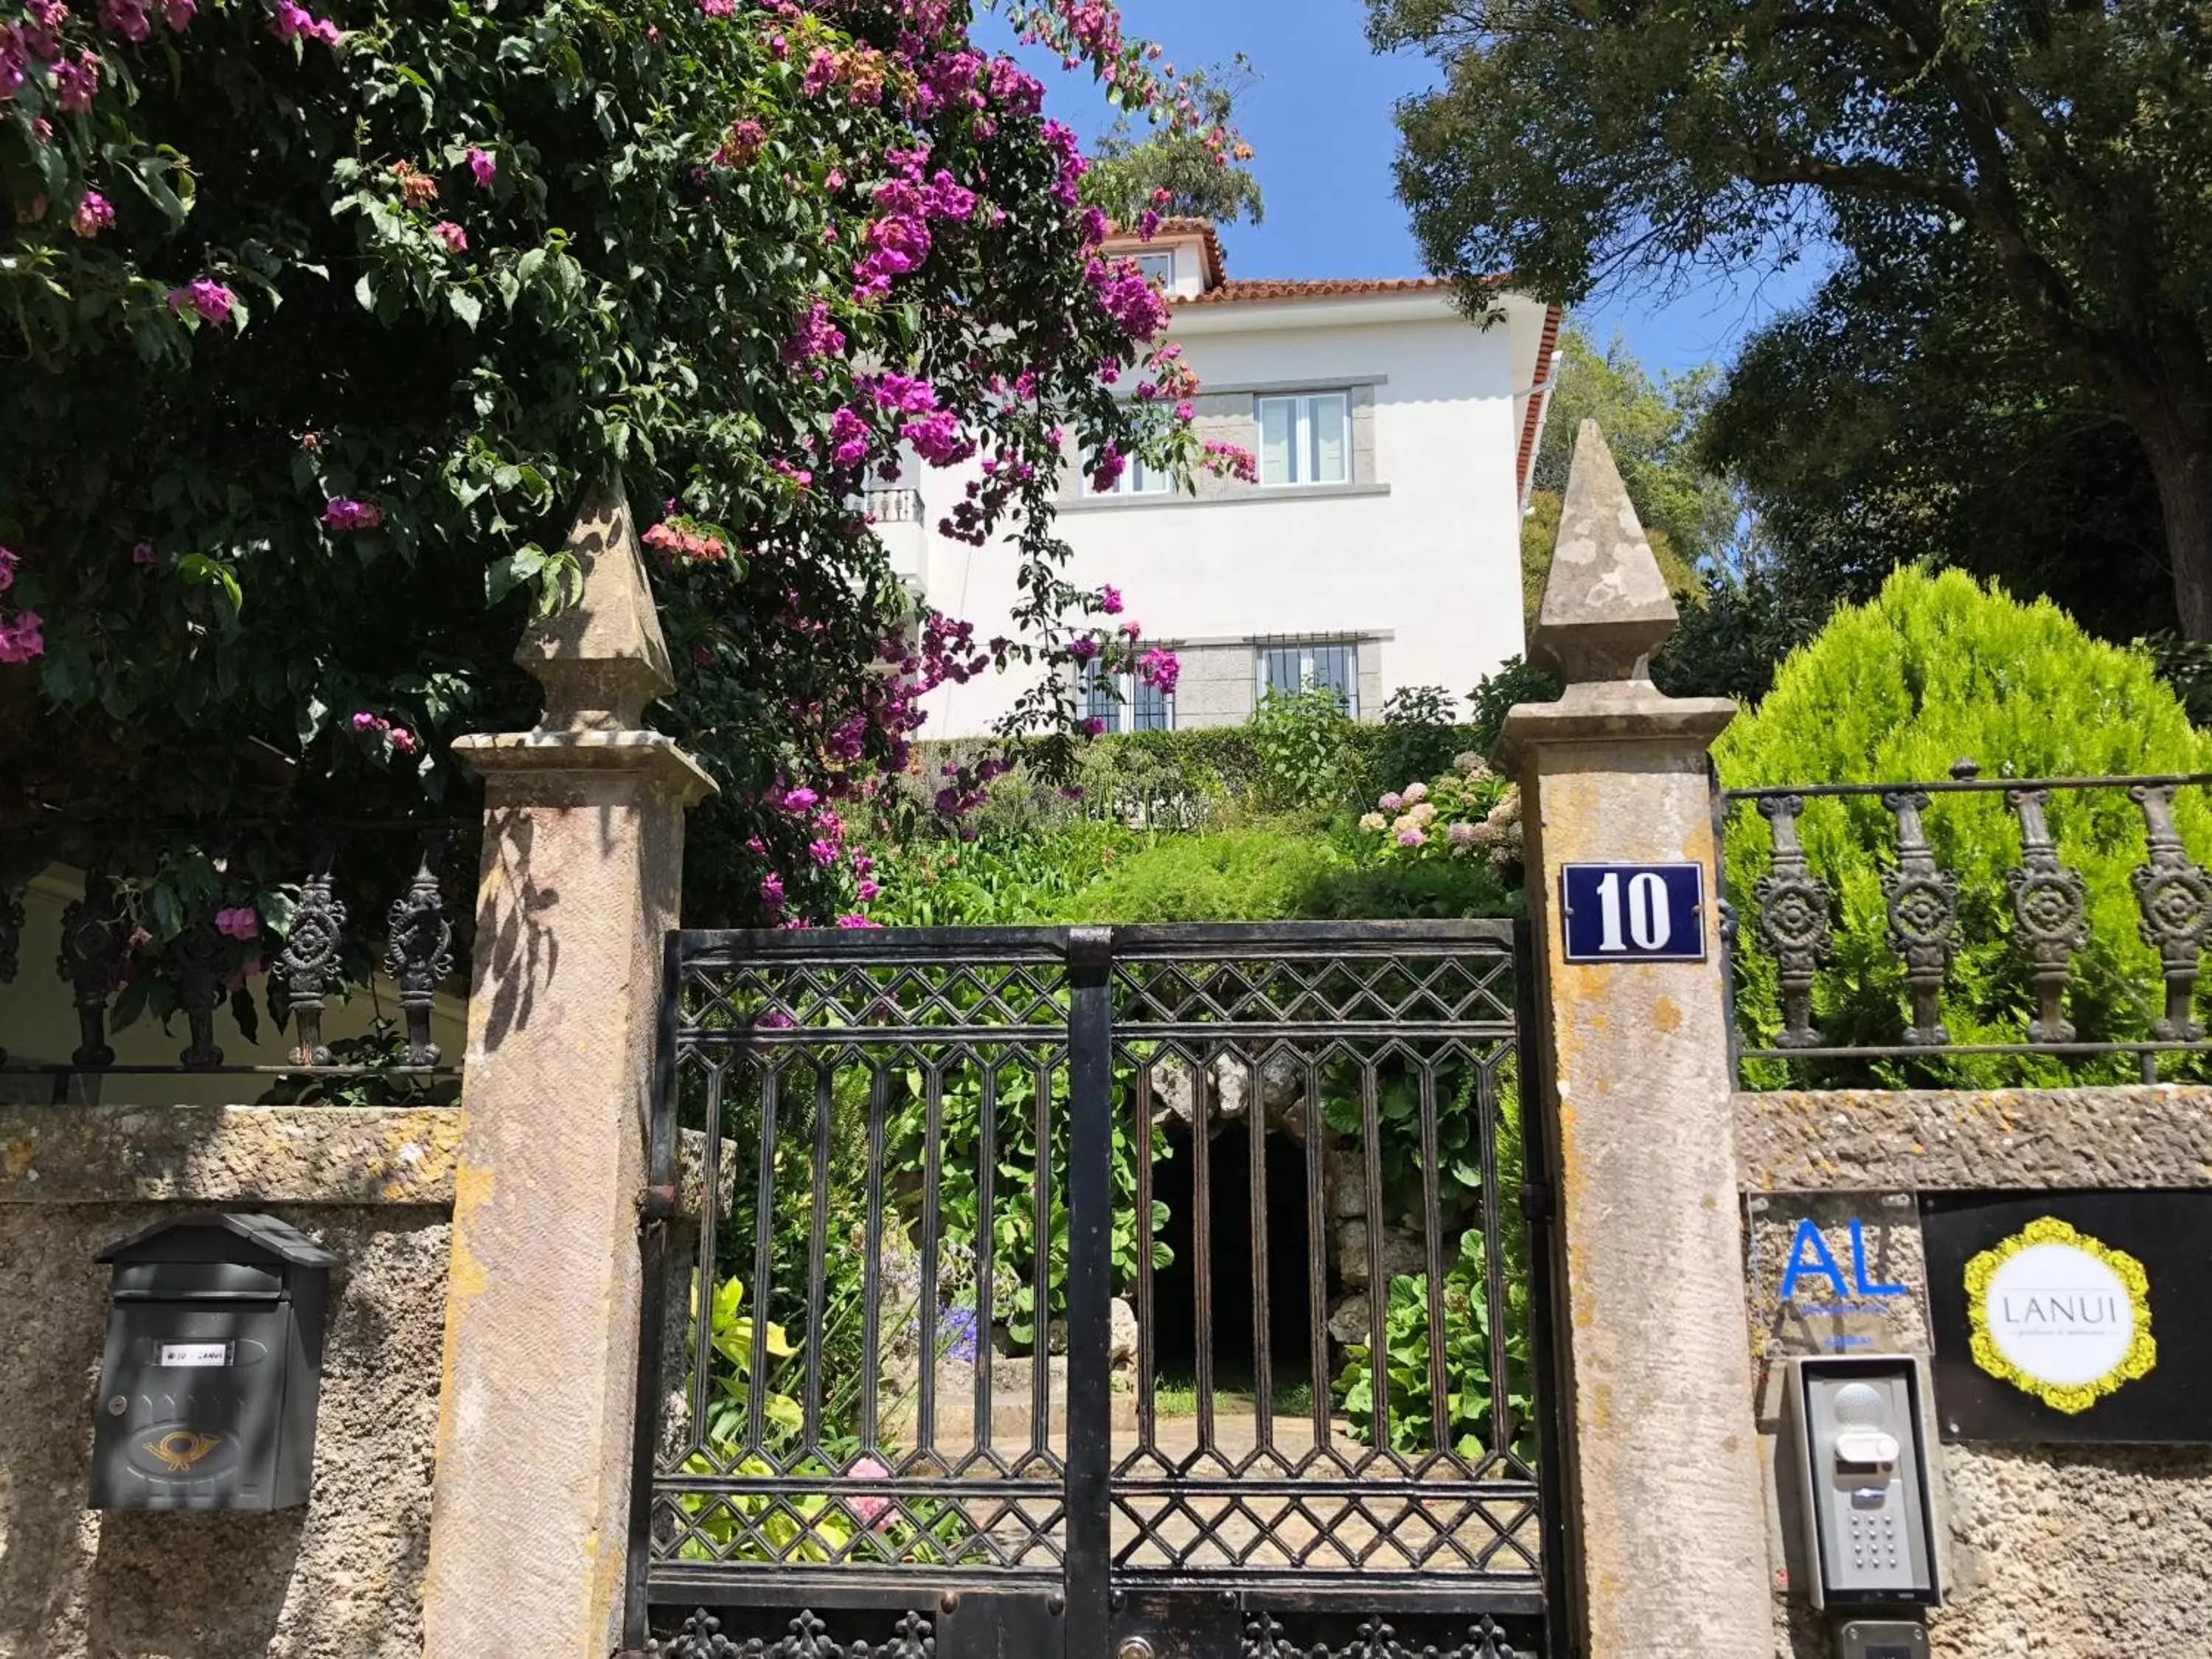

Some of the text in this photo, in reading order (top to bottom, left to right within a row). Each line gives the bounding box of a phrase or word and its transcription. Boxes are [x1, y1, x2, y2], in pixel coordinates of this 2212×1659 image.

[1596, 872, 1671, 950] 10
[1780, 1217, 1907, 1298] AL
[2003, 1296, 2116, 1324] LANUI
